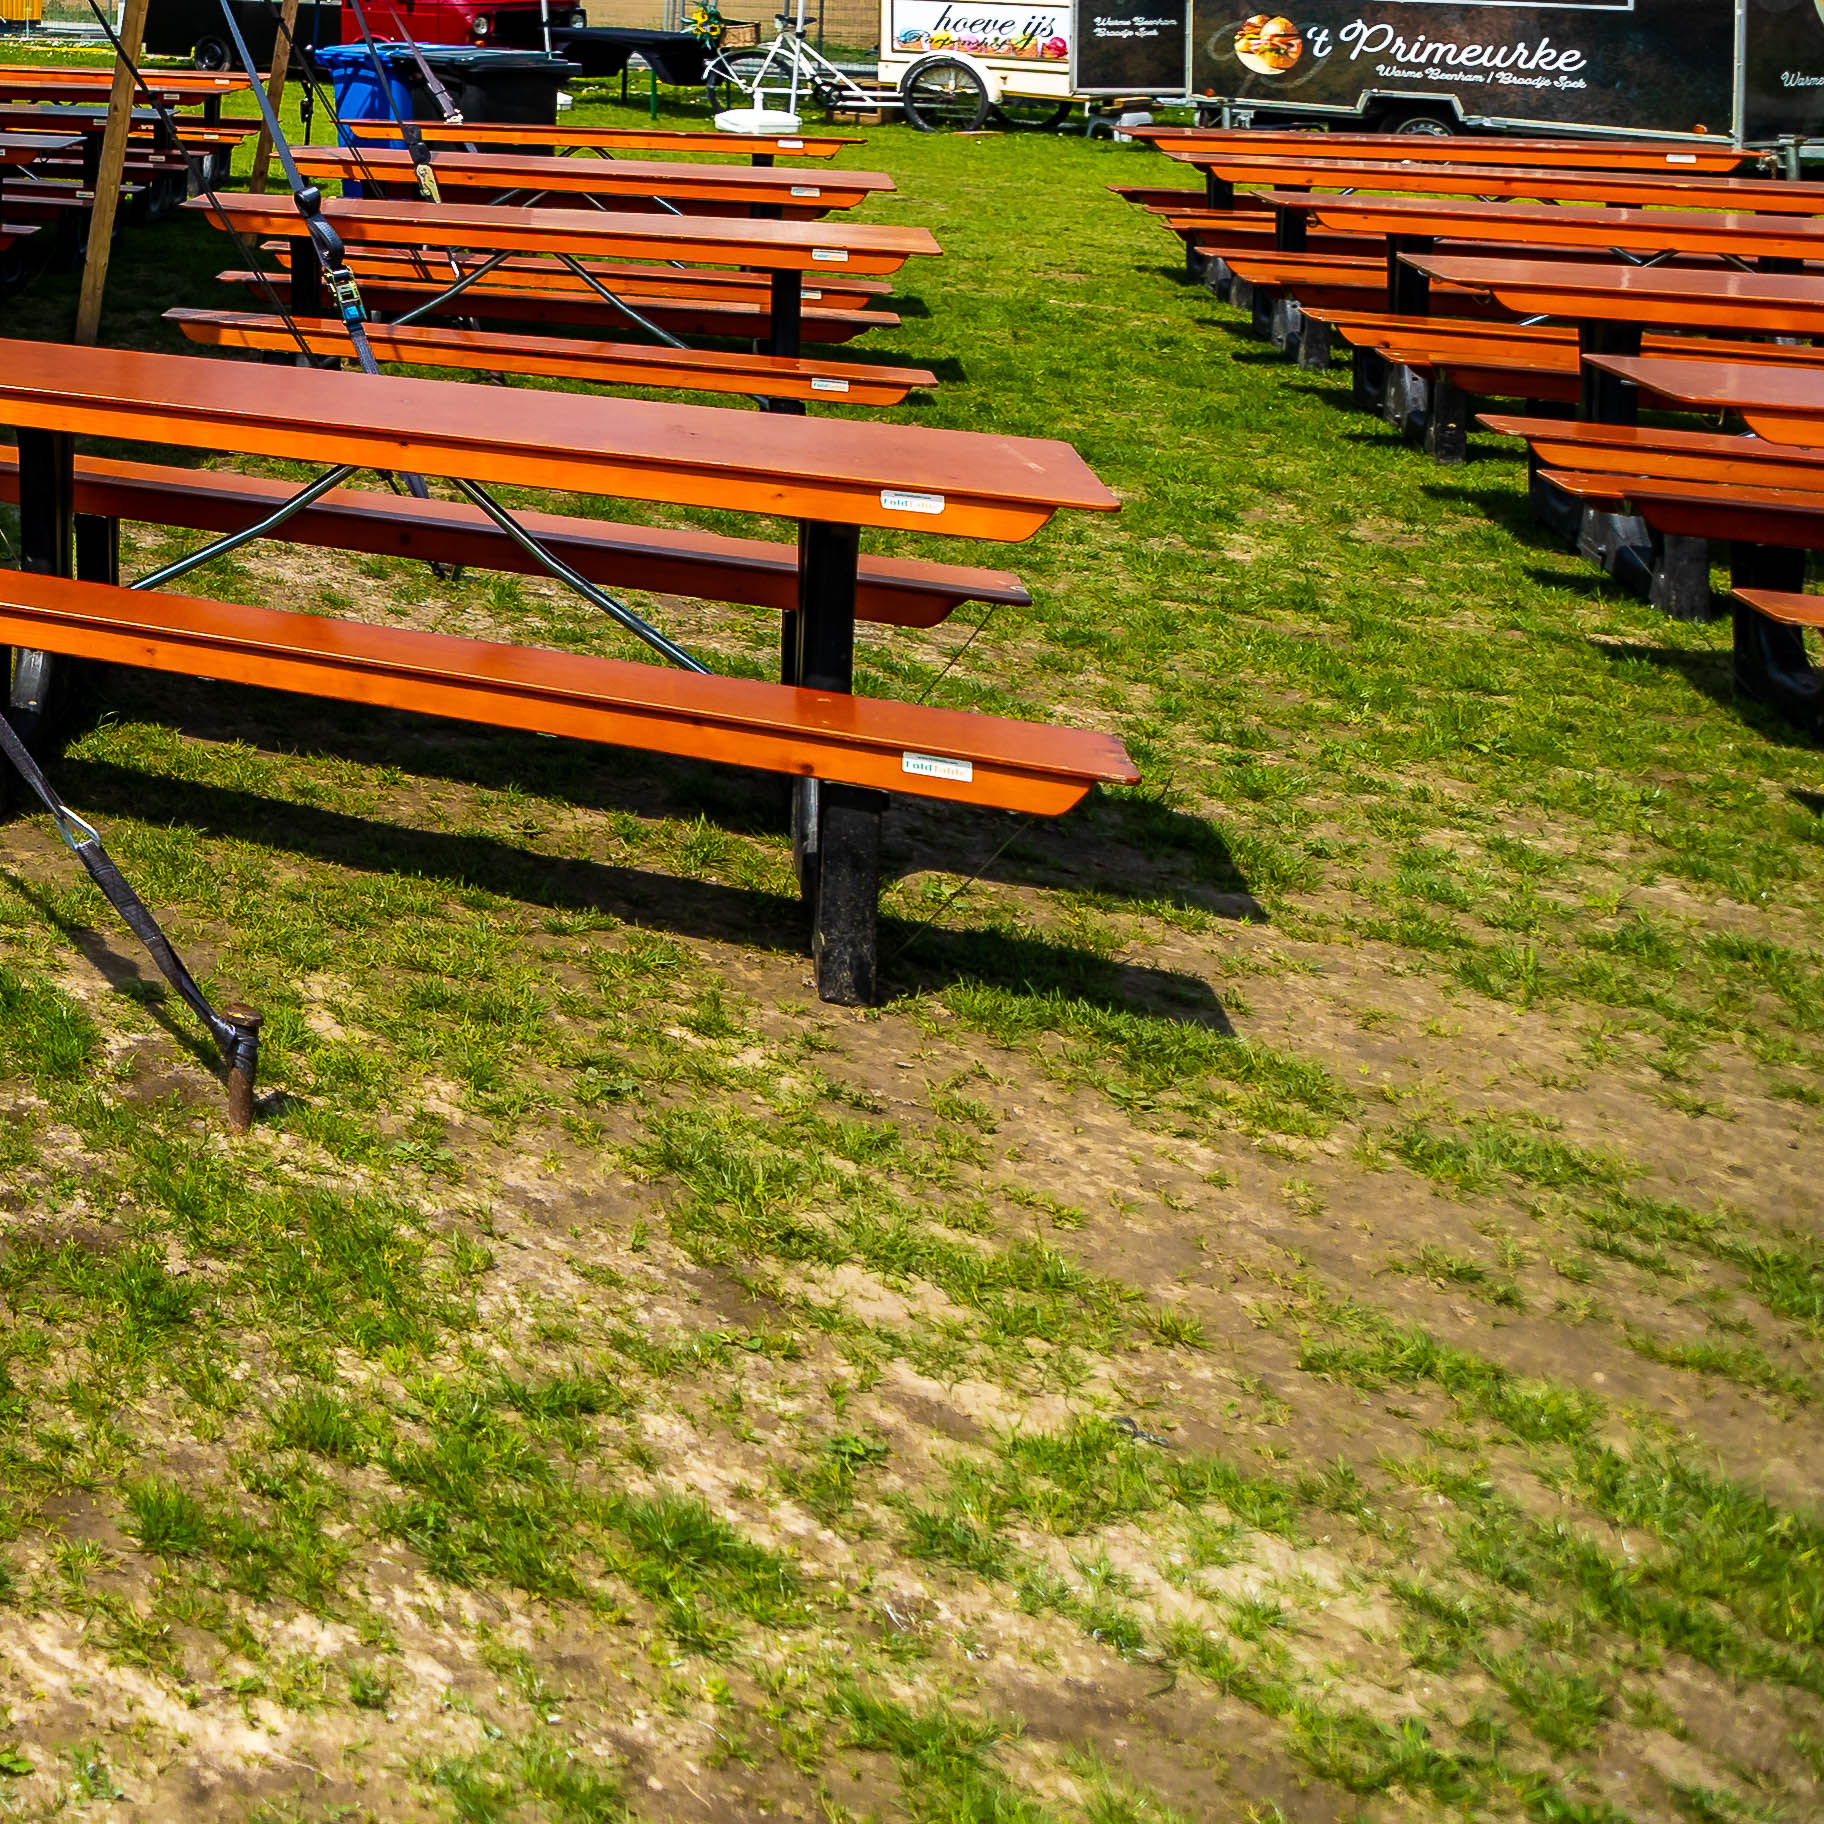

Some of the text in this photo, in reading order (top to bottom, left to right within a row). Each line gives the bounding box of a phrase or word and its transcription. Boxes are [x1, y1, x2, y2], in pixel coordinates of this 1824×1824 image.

[933, 4, 1056, 50] hoeve ijs
[1339, 18, 1587, 72] Primeurke
[1375, 63, 1423, 79] Warme
[1424, 66, 1485, 83] Beenham
[1495, 71, 1551, 89] Broodje
